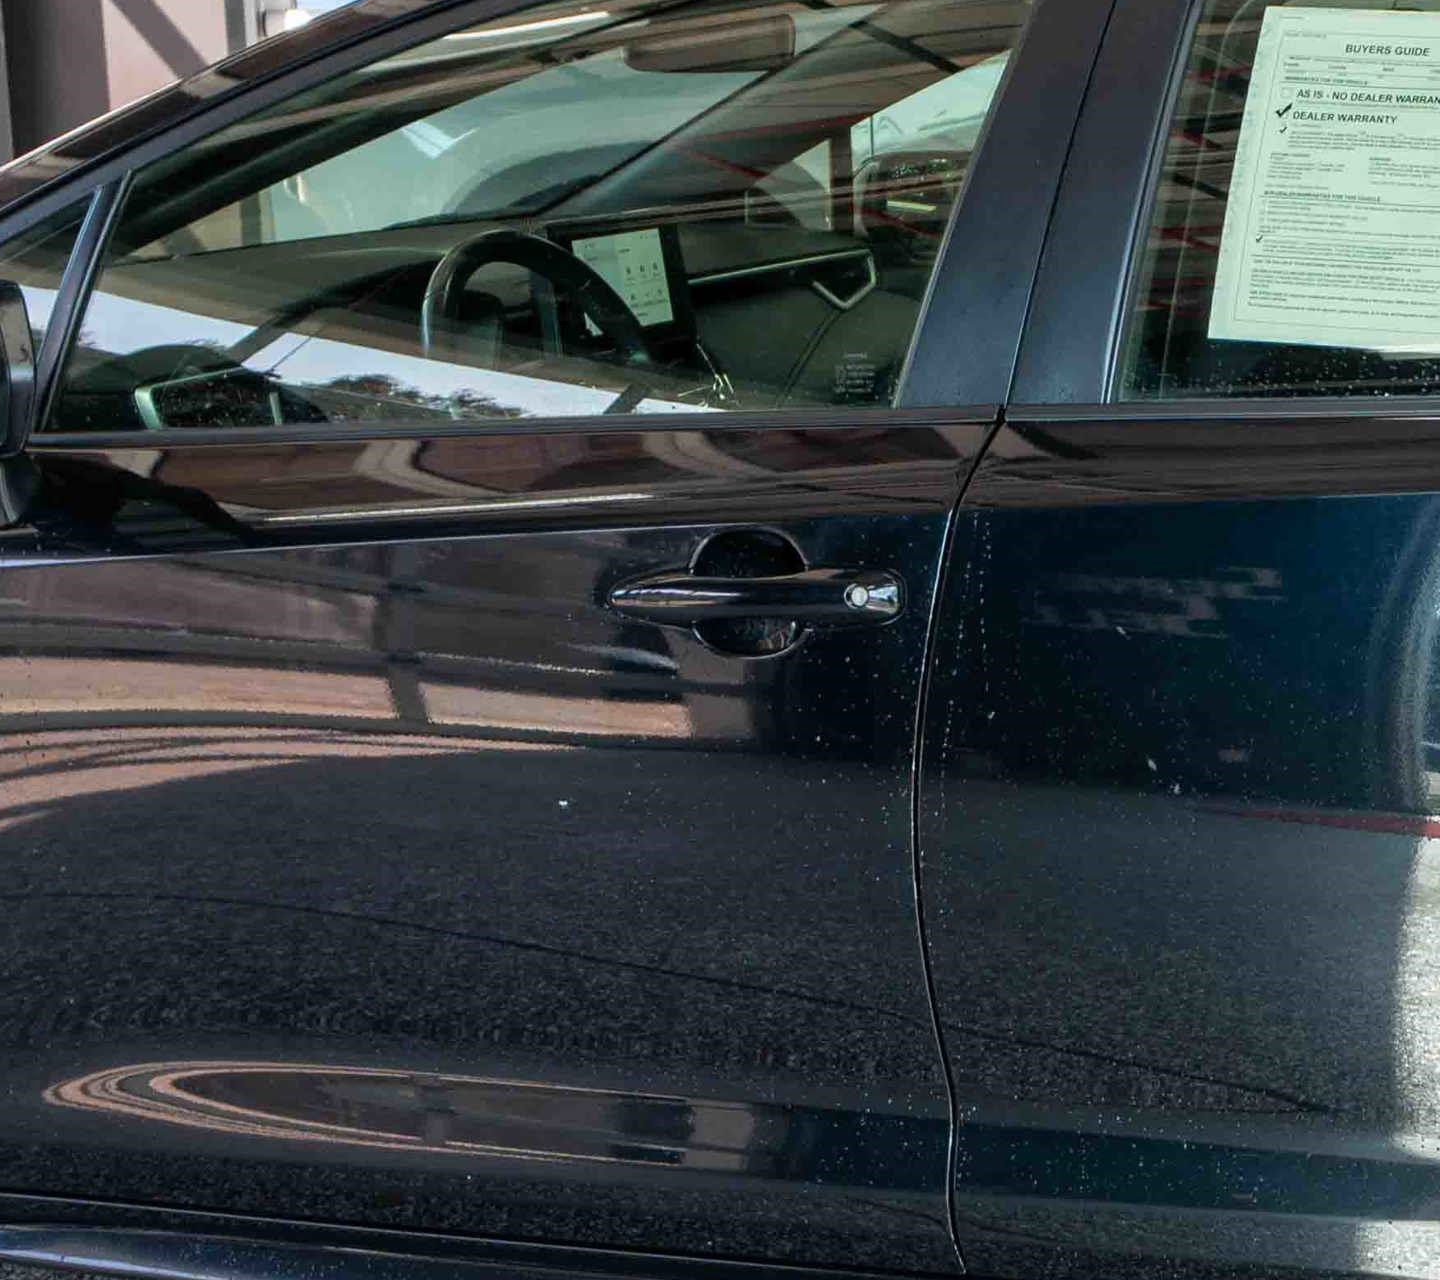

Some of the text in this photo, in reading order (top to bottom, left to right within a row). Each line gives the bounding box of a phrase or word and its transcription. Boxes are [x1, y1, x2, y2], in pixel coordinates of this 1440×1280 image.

[1345, 44, 1431, 57] BUYERS GUIDE
[1296, 88, 1311, 98] AS
[1312, 89, 1324, 99] IS
[1331, 91, 1348, 101] NO
[1350, 93, 1393, 104] DEALER
[1292, 111, 1398, 124] DEALER WARRANTY
